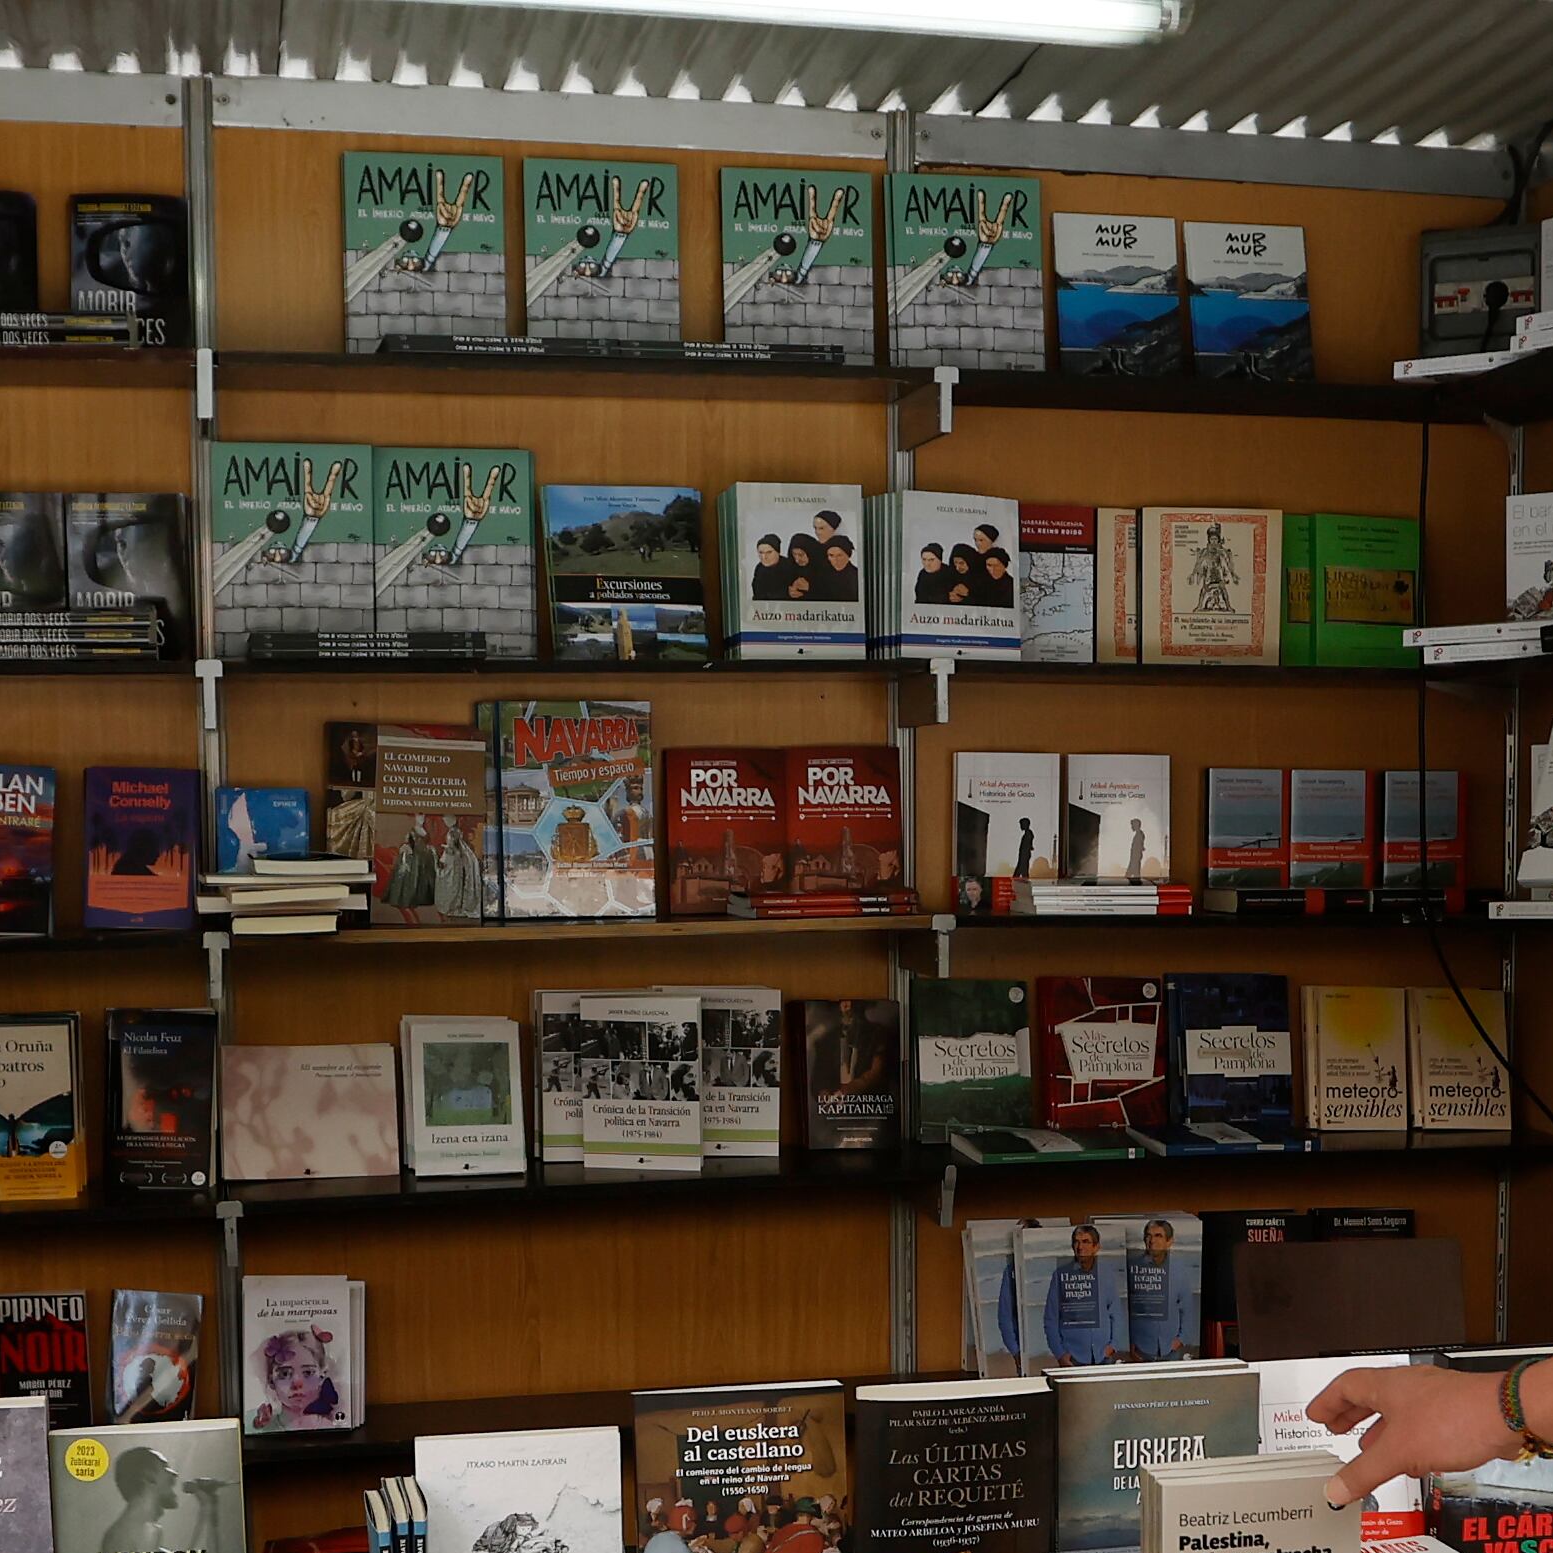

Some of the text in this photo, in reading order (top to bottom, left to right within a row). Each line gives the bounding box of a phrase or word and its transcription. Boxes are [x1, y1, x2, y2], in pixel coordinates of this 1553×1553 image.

[1096, 224, 1137, 237] MUR
[1225, 232, 1266, 244] MUR
[1096, 236, 1137, 249] MUR
[1226, 244, 1267, 257] MUR
[596, 577, 663, 591] Excursiones
[597, 588, 633, 601] poblados
[635, 589, 670, 601] vascones
[752, 608, 855, 623] Auzo madarikatua
[909, 611, 1014, 628] Auzo madarikatua
[512, 716, 641, 767] NAVARRA
[384, 752, 451, 764] EL COMERCIO
[384, 763, 428, 774] NAVARRO
[554, 761, 634, 782] Tiempo y espacio
[384, 775, 467, 787] CON INGLATERRA
[691, 769, 738, 788] POR
[383, 785, 396, 796] EN
[399, 786, 411, 796] EL
[414, 787, 442, 797] SIGLO
[681, 787, 774, 808] NAVARRA
[934, 1040, 1016, 1059] Secretos
[953, 1057, 968, 1066] de
[941, 1062, 1010, 1079] Pamplona
[1325, 1084, 1404, 1099] meteoro-
[1324, 1100, 1404, 1120] sensibles
[687, 1423, 799, 1443] Del euskera
[684, 1442, 803, 1462] al castellano
[889, 1440, 1027, 1465] Las ÚLTIMAS
[914, 1464, 1002, 1485] CARTAS
[889, 1479, 1024, 1508] del REQUETÉ
[1179, 1506, 1313, 1528] Beatriz Lecumberri
[1463, 1517, 1498, 1542] EL
[1179, 1531, 1270, 1551] Palestina,
